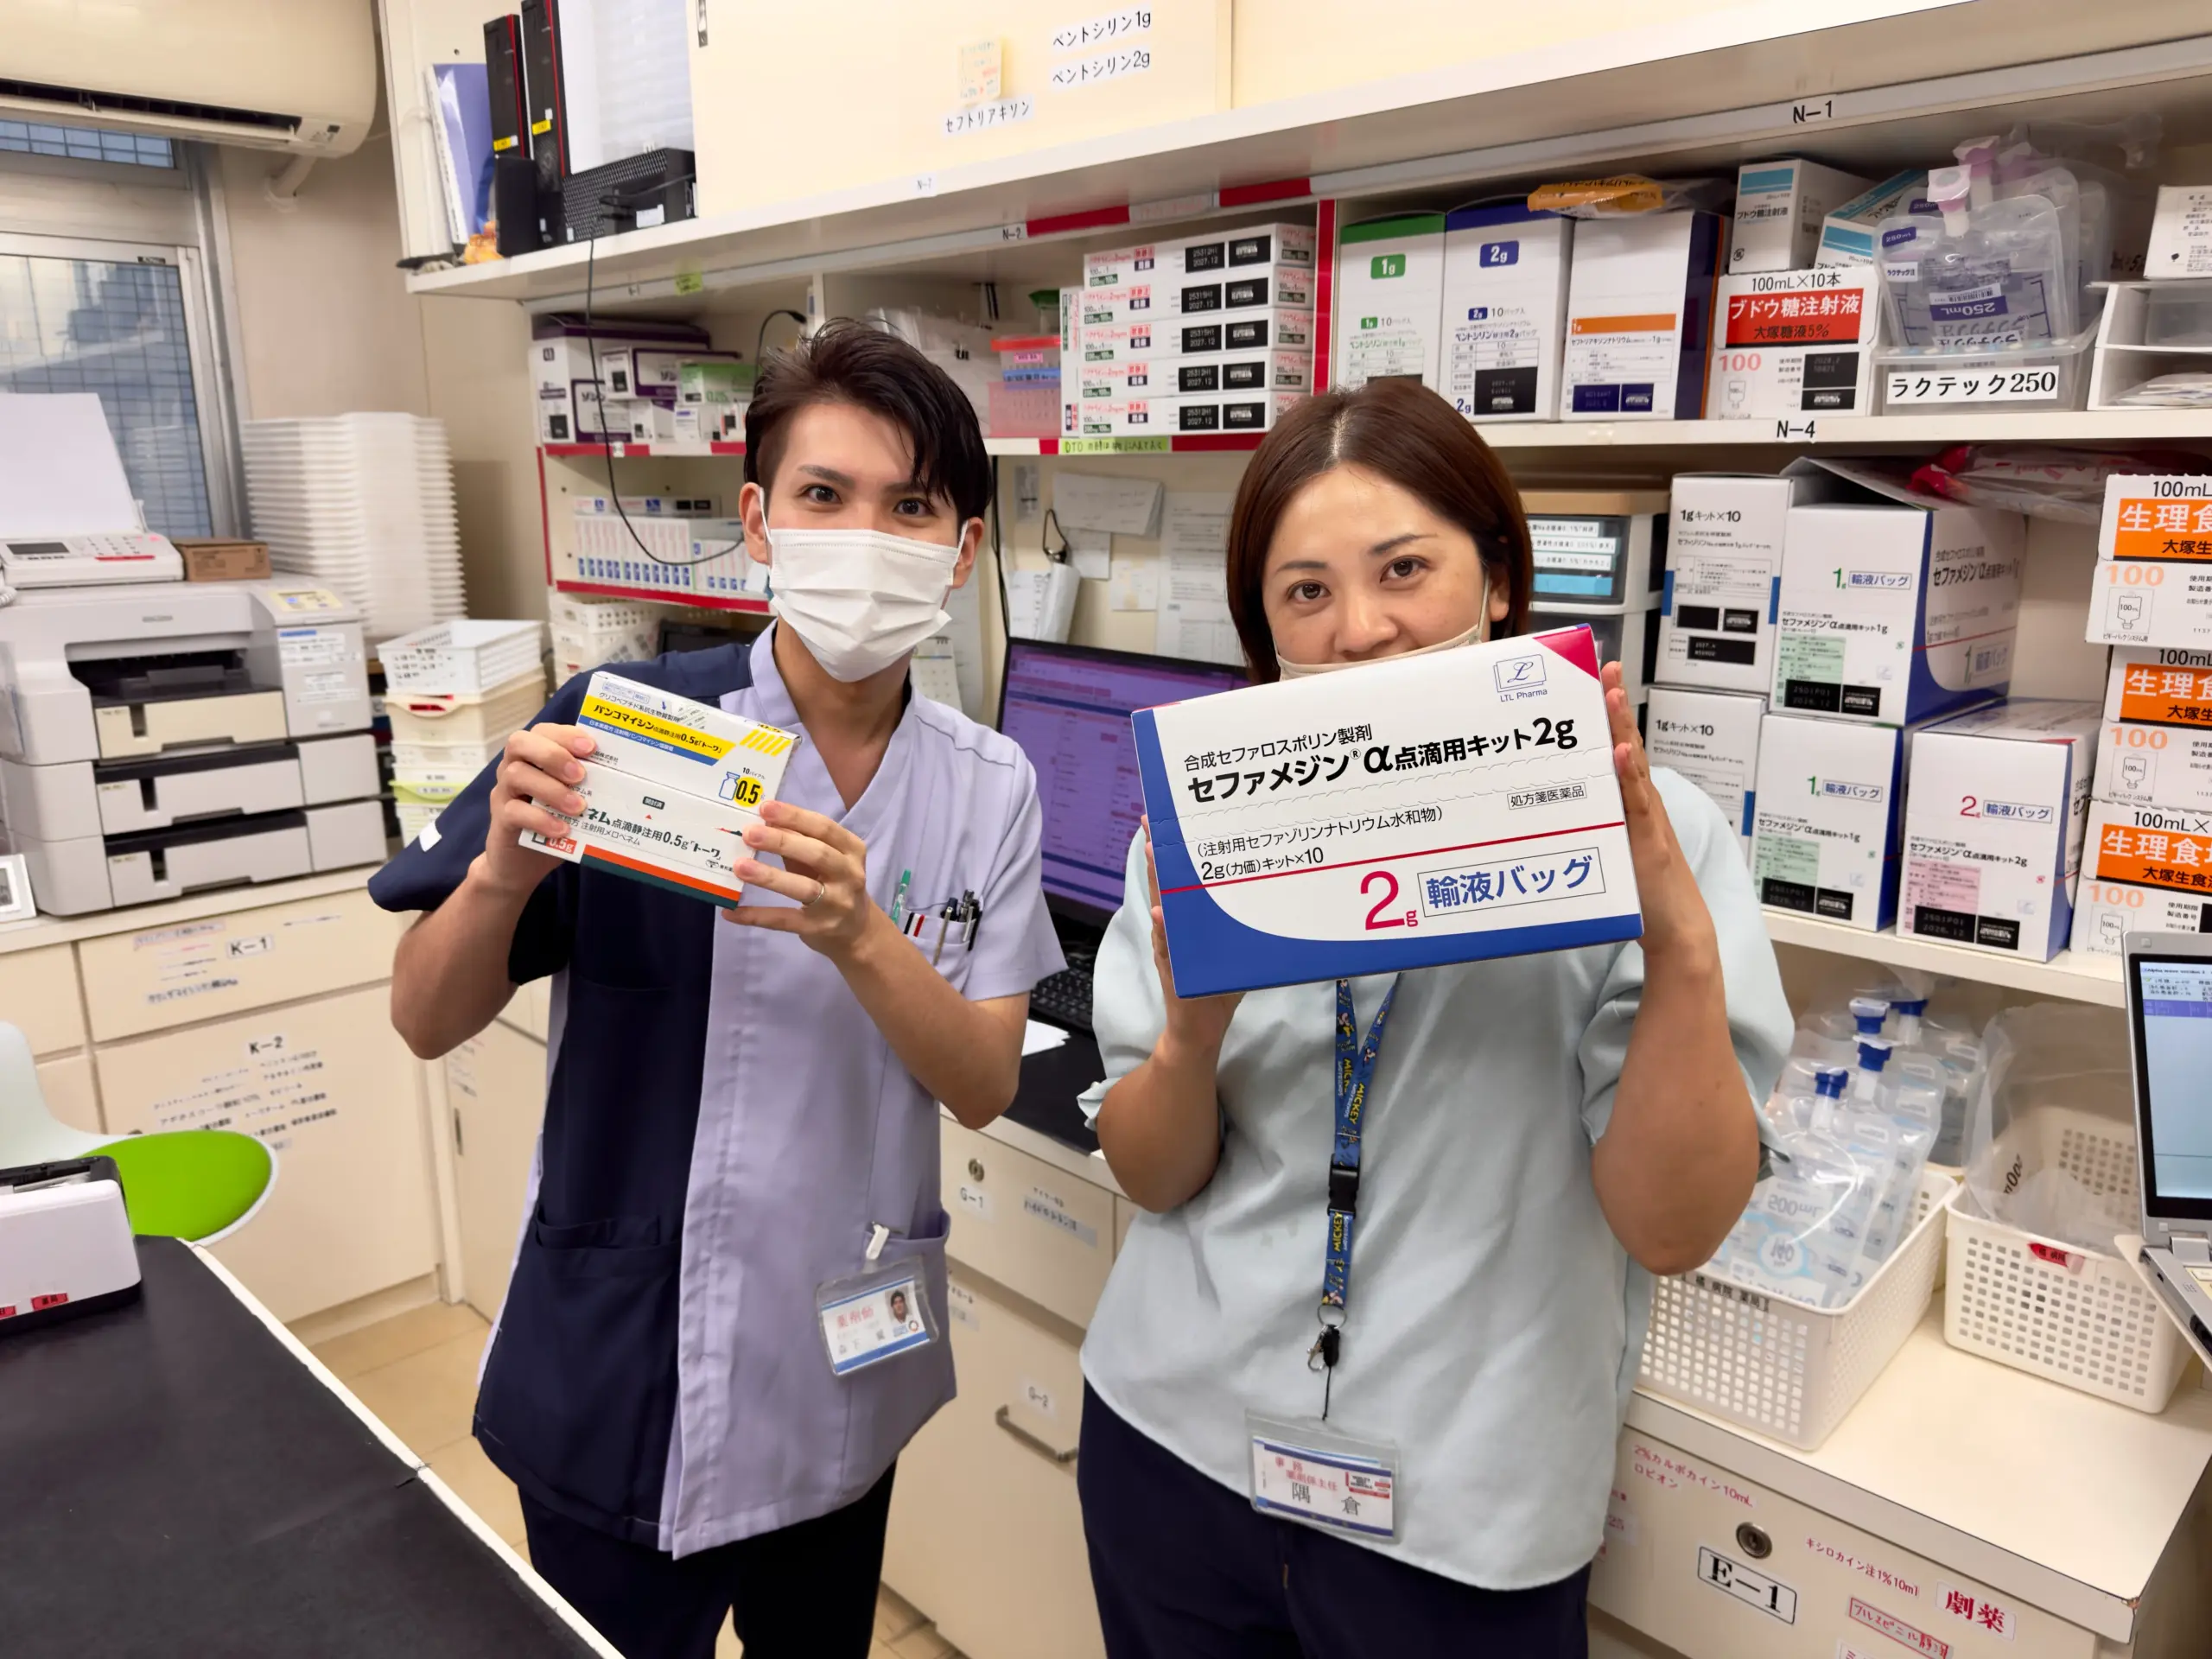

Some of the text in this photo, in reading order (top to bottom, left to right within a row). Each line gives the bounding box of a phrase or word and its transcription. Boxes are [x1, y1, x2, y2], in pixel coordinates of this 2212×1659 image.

[1794, 100, 1834, 123] N-1
[1002, 226, 1024, 241] N-2
[1491, 245, 1508, 263] 2g
[1382, 257, 1396, 276] 1g
[1730, 293, 1861, 320] ブドウ糖注射液
[1941, 302, 1995, 316] 250mL
[1753, 323, 1831, 340] 大塚糖液5%
[1718, 353, 1762, 372] 100
[1891, 371, 2056, 398] ラクテック250
[1777, 419, 1816, 439] N-4
[1679, 508, 1742, 523] 1gキット×10
[1851, 574, 1910, 588] 輸液バッグ
[2105, 563, 2164, 587] 100
[1500, 688, 1548, 703] LTL Pharma
[1656, 718, 1714, 737] 1gキット×10
[2109, 726, 2169, 750] 100
[1184, 723, 1374, 772] 合成セファロスポリン製剤
[736, 780, 760, 804] 0.5
[1510, 785, 1585, 810] 処方箋医薬品
[1825, 781, 1880, 799] 輸液バッグ
[1986, 802, 2050, 821] 輸液バッグ
[579, 808, 722, 861] ネム点滴静注用0.5g「トーワ」
[581, 822, 640, 846] 注射用メロペネム
[2101, 829, 2212, 868] 生理食
[1359, 854, 1593, 931] 2g 輸液バッグ
[2088, 883, 2145, 908] 100
[230, 937, 268, 956] K-1
[249, 1035, 283, 1054] K-2
[1348, 1081, 1366, 1126] MICKEY
[1332, 1211, 1344, 1252] MICKEY
[1707, 1554, 1782, 1614] E-1
[1945, 1591, 2006, 1634] 劇薬
